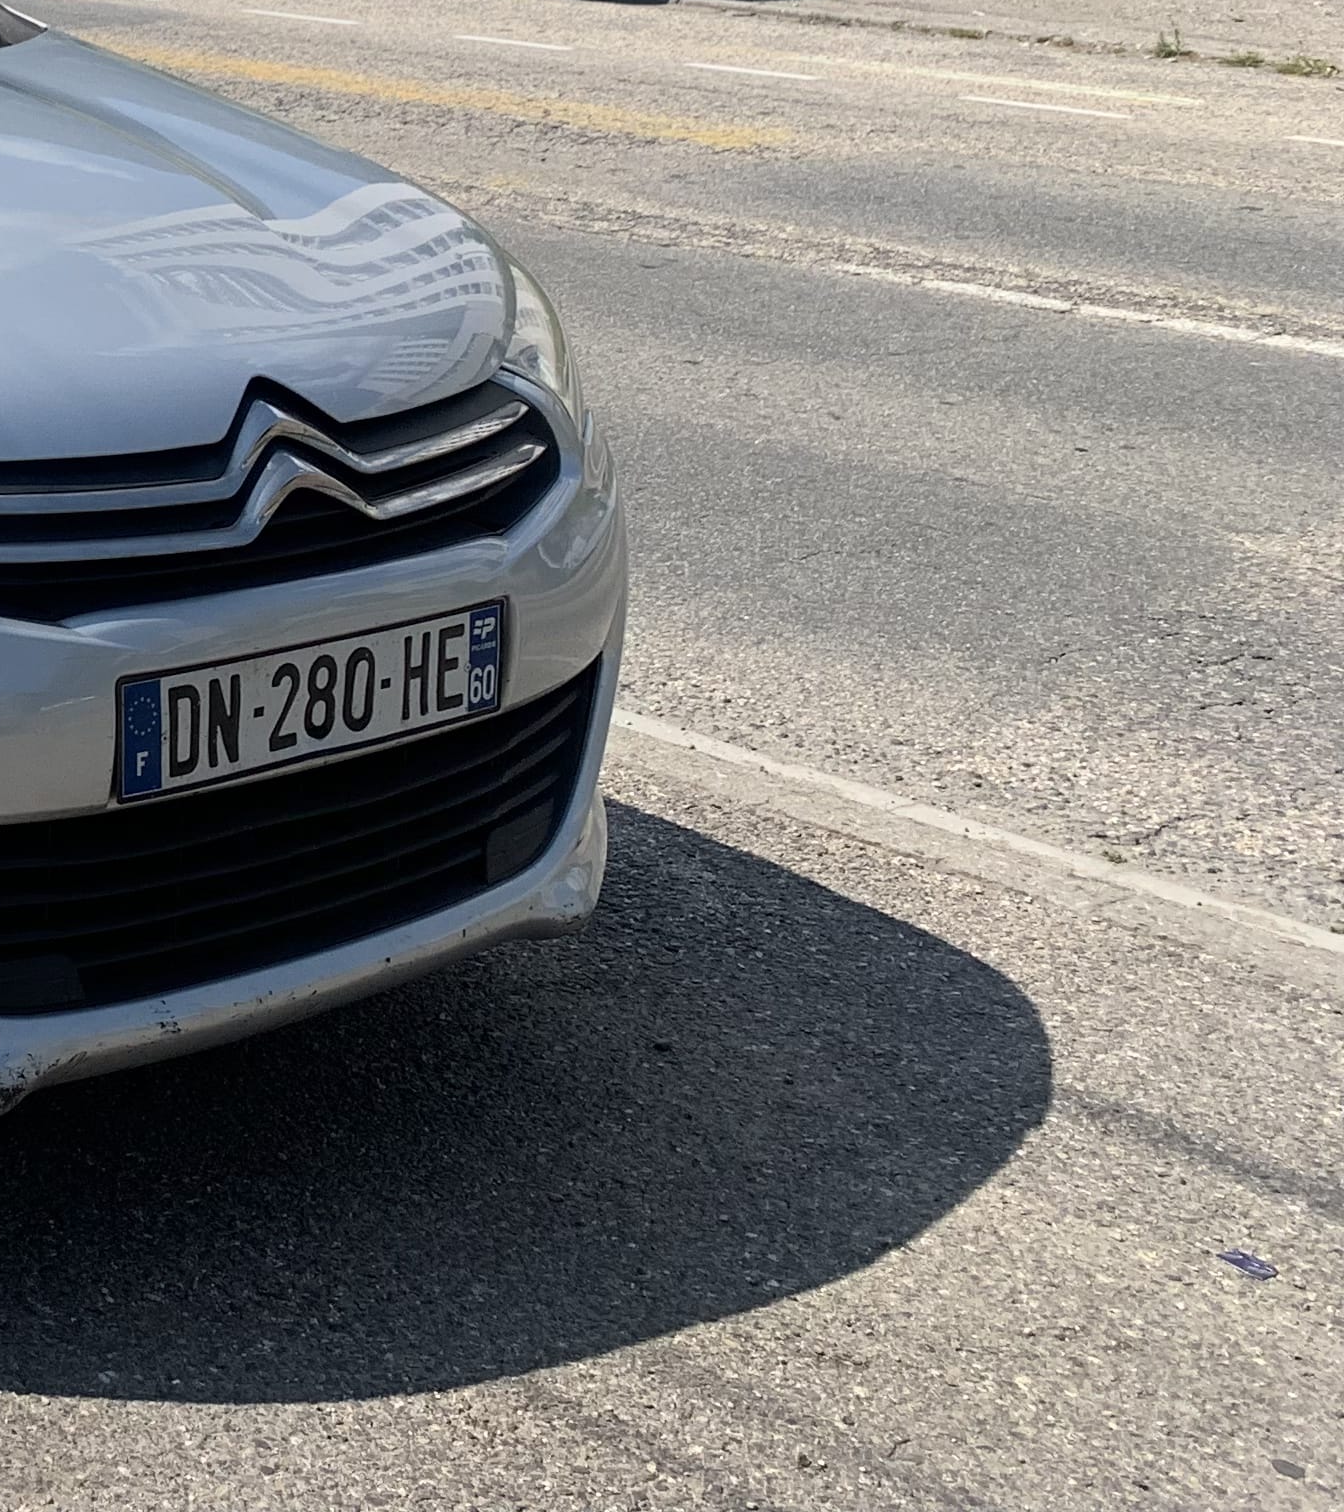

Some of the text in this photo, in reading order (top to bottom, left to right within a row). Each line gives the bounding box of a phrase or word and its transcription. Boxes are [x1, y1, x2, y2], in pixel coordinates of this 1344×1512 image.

[168, 624, 464, 777] DN-280-HE
[470, 664, 495, 703] 60
[136, 752, 148, 777] F
